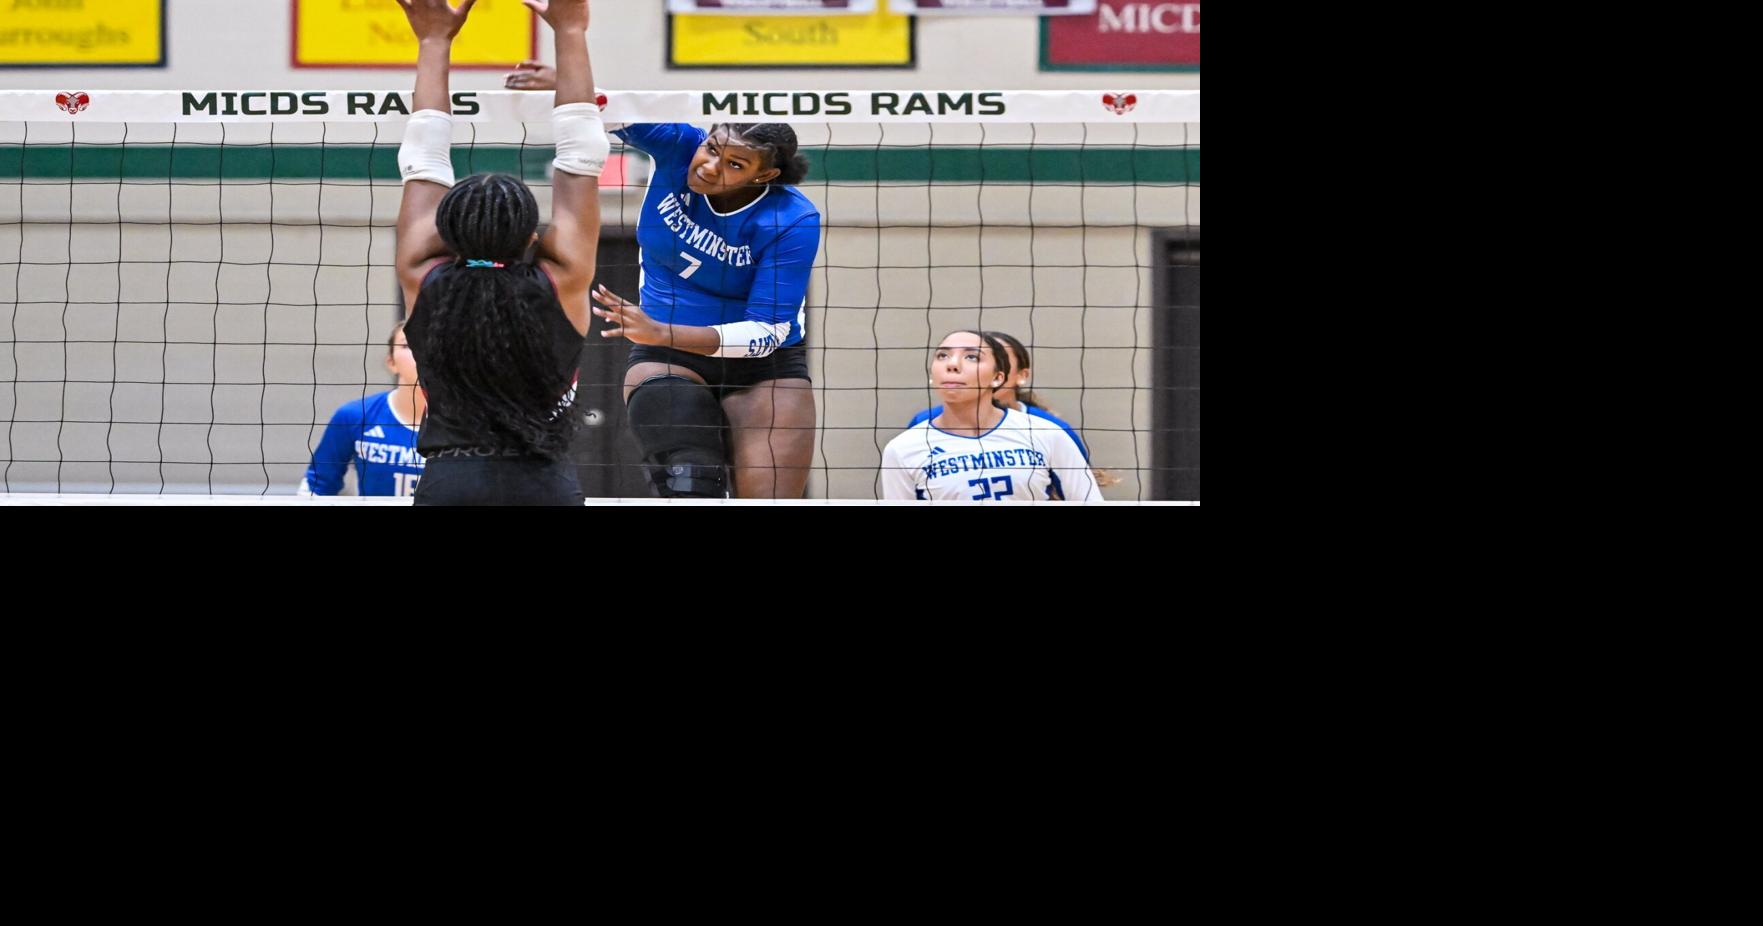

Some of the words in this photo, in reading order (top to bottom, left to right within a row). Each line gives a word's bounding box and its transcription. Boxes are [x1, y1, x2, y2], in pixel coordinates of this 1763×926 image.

[744, 20, 840, 46] South
[182, 92, 329, 115] MICDS
[347, 92, 479, 115] RAS
[702, 92, 852, 115] MICDS
[871, 92, 1005, 115] RAMS
[656, 192, 754, 267] WESTMINSTER
[678, 251, 702, 279] 7
[922, 449, 1046, 480] WESTMINSTER
[968, 475, 1013, 500] 22
